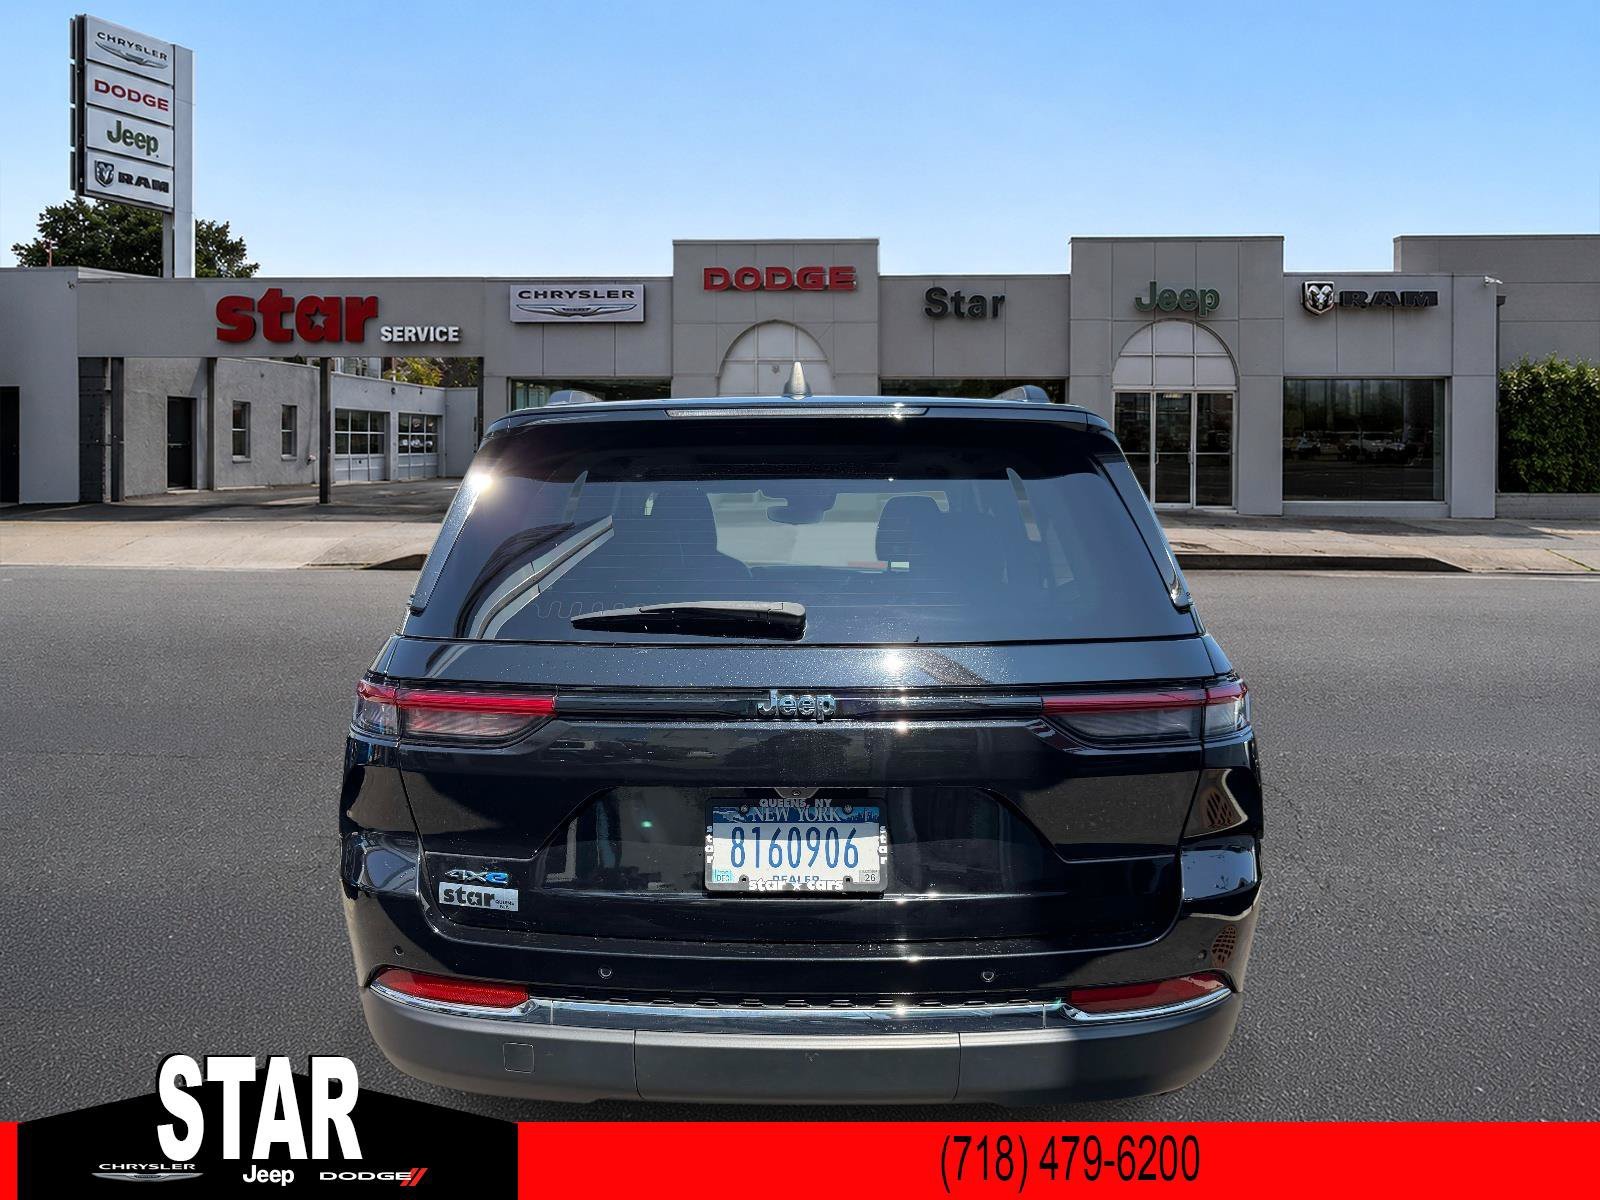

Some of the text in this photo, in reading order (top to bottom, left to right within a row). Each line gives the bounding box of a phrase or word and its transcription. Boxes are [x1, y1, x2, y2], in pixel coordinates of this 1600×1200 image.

[96, 31, 168, 61] CHRYSLER
[94, 79, 169, 111] DODGE
[107, 120, 159, 156] Jeep
[118, 171, 169, 193] RAM
[703, 266, 857, 292] DODGE
[518, 290, 635, 299] CHRYSLER
[923, 286, 1006, 320] Star
[1134, 281, 1221, 317] Jeep
[1339, 290, 1439, 308] RAM
[216, 287, 460, 343] star SERVICE
[757, 689, 837, 724] Jeep
[752, 807, 841, 821] NEW YORK
[815, 799, 832, 807] NY
[731, 826, 858, 868] 8160906
[807, 879, 843, 891] cars
[865, 873, 876, 882] 26
[443, 886, 496, 907] star
